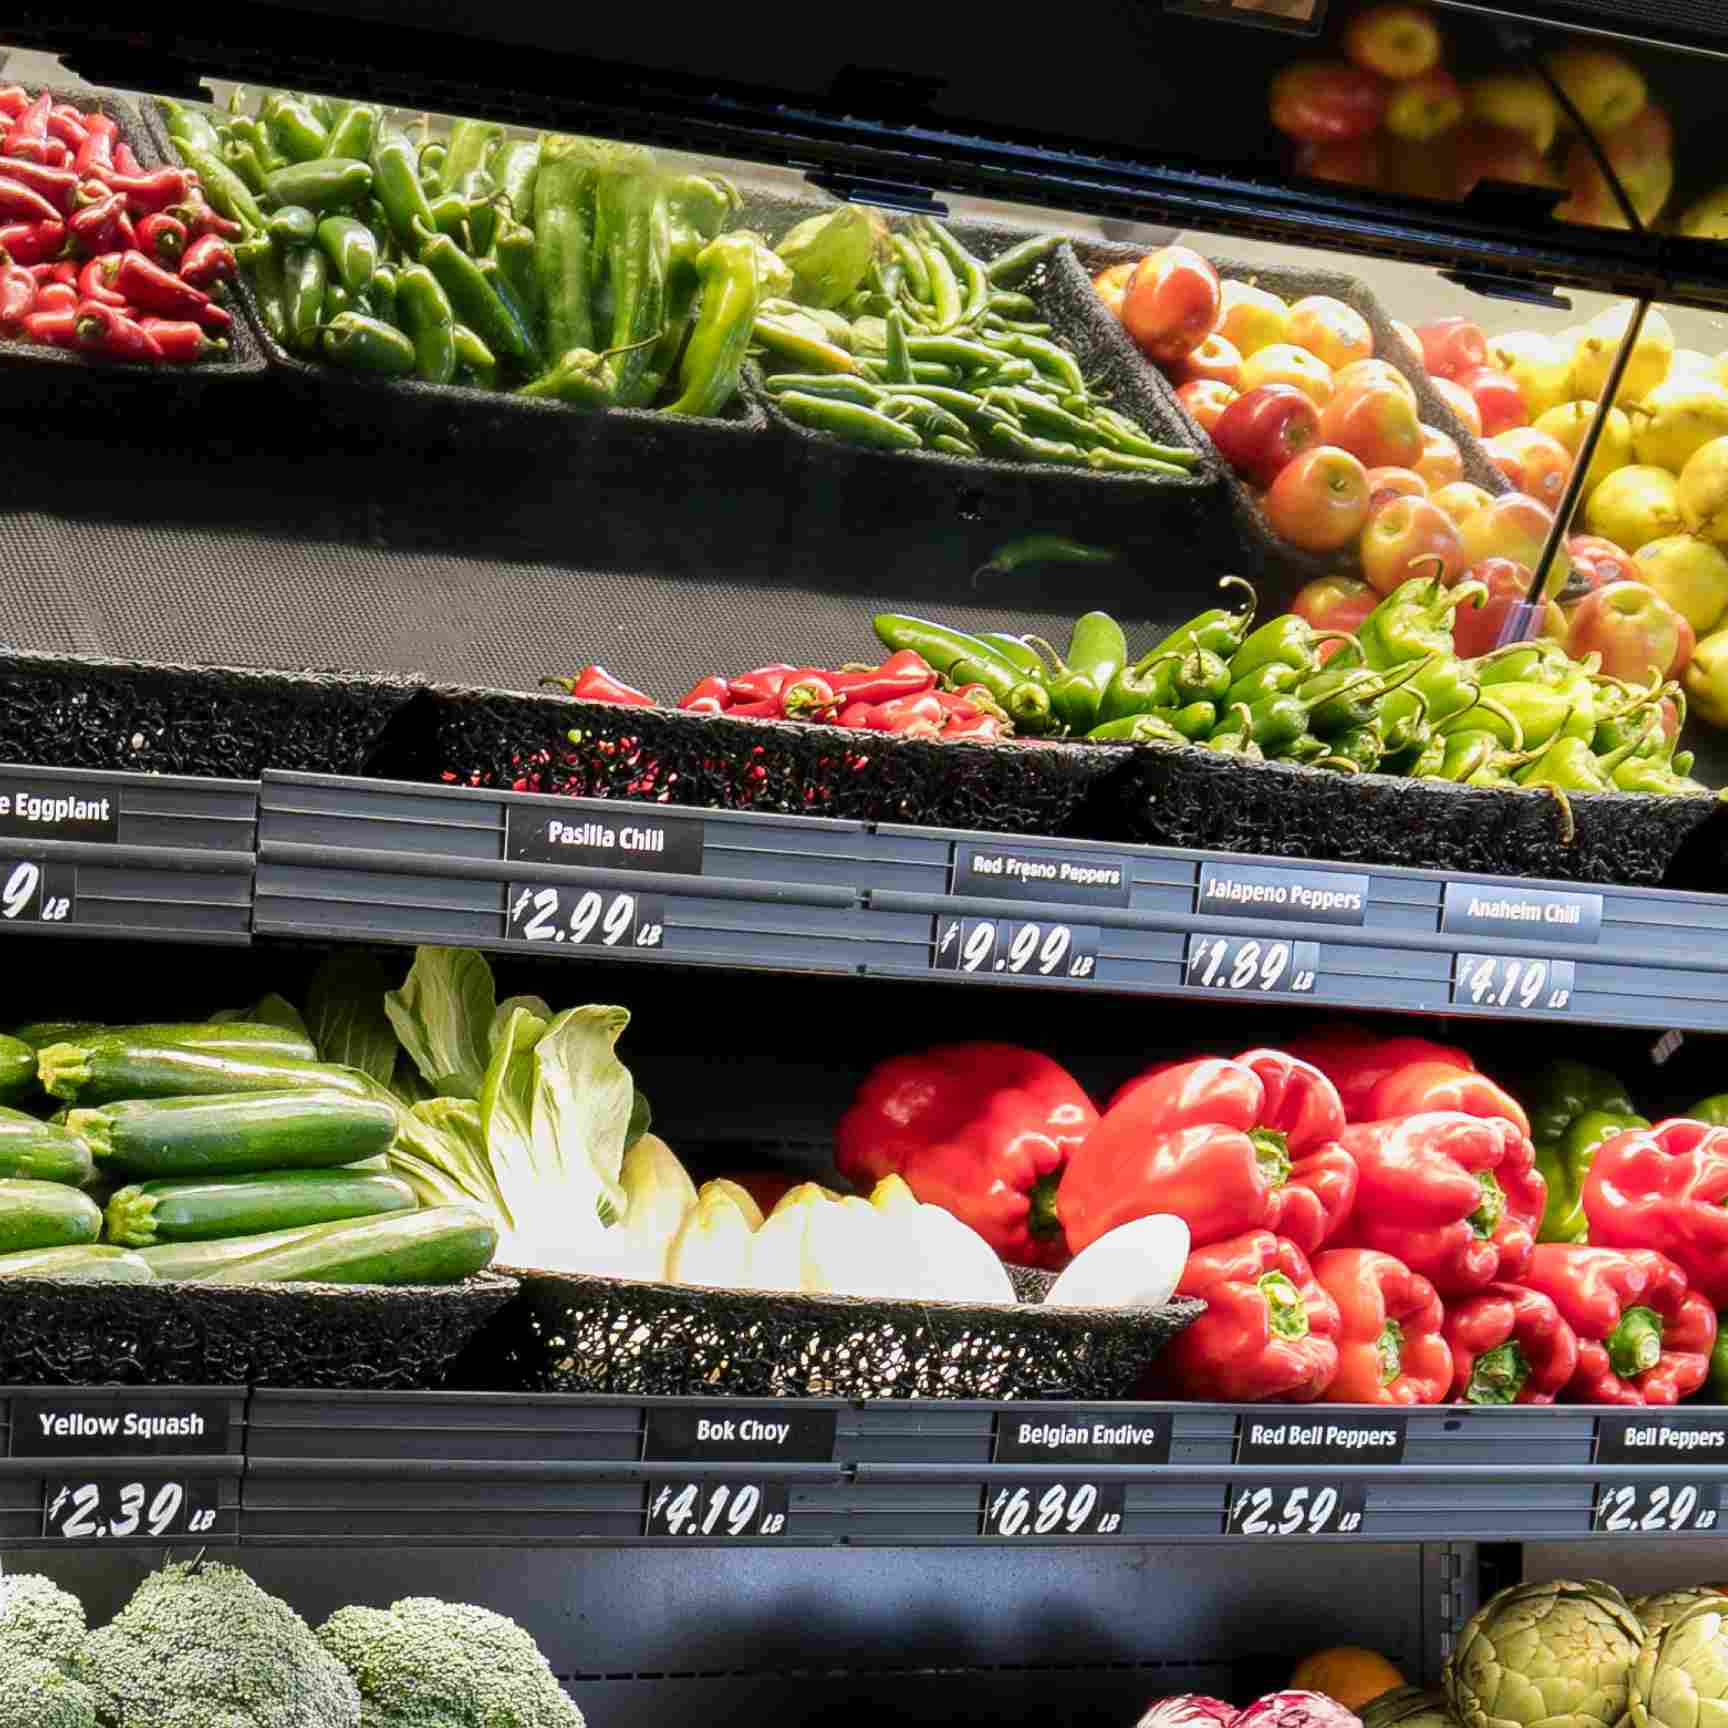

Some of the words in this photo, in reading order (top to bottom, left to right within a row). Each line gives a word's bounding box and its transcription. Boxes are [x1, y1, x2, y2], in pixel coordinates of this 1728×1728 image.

[16, 793, 109, 821] Eggplant
[549, 821, 615, 847] Pasilla
[620, 827, 663, 851] Chili
[973, 856, 1003, 873] Red
[1006, 859, 1056, 882] Fresno
[1060, 861, 1120, 884] Peppers
[1206, 878, 1287, 903] Jalapeno
[1290, 880, 1365, 910] Peppers
[512, 888, 634, 947] $2.99
[1466, 897, 1540, 922] Anaheim
[1543, 900, 1581, 924] Chili
[940, 921, 1071, 974] $9.99
[1192, 936, 1290, 990] $1.89
[1457, 955, 1550, 1008] $4.19
[40, 1414, 119, 1435] Yellow
[123, 1413, 203, 1438] Squash
[697, 1420, 735, 1440] Bok
[740, 1420, 789, 1444] Choy
[1018, 1424, 1088, 1448] Belgian
[1092, 1424, 1154, 1444] Endive
[1251, 1425, 1286, 1444] Red
[1288, 1426, 1323, 1445] Bell
[1326, 1426, 1396, 1448] Peppers
[1624, 1427, 1657, 1446] Bell
[1659, 1428, 1724, 1449] Peppers
[49, 1483, 182, 1538] $2.39
[652, 1484, 759, 1535] $4.19
[990, 1484, 1097, 1536] $6.89
[1234, 1487, 1337, 1536] $2.59
[1596, 1486, 1696, 1533] $2.29
